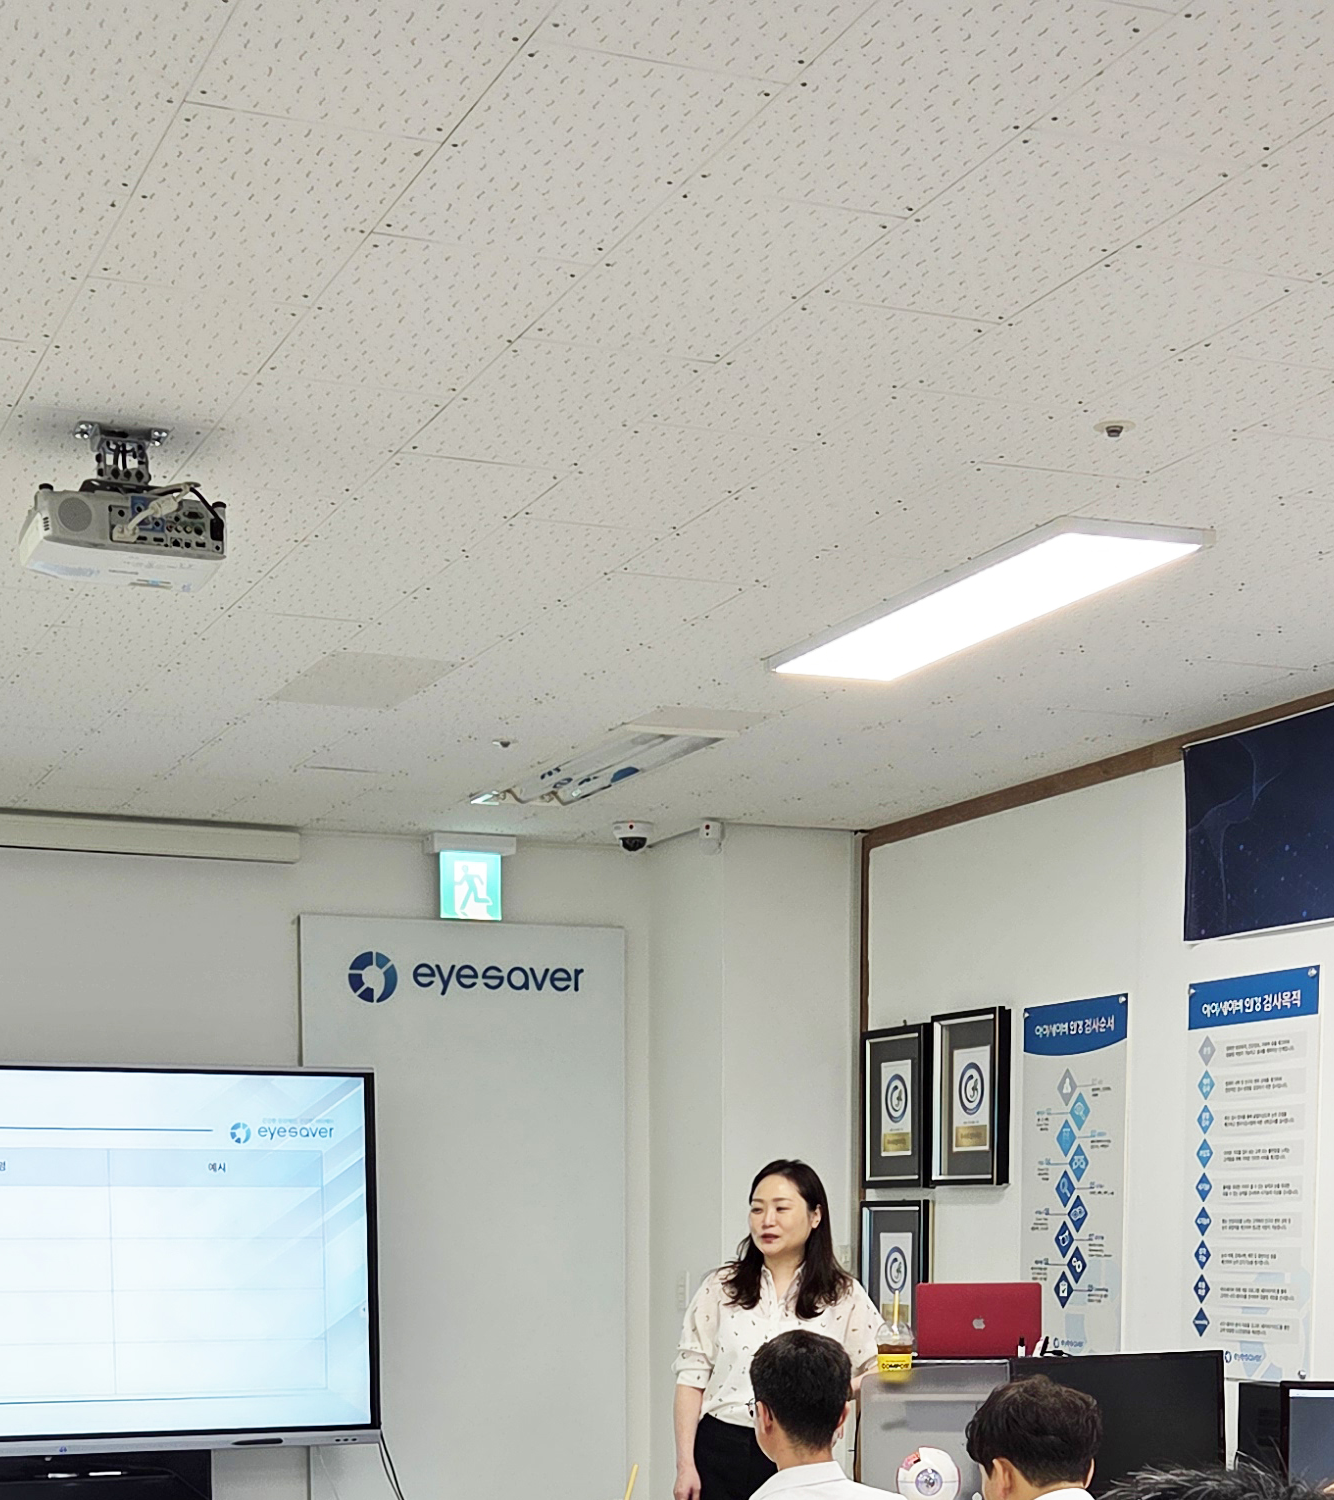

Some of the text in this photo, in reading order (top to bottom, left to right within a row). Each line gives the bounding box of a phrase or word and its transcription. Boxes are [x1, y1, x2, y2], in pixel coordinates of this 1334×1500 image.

[413, 963, 584, 995] eyesaver
[258, 1126, 335, 1140] eyesaver
[208, 1162, 227, 1173] 예시
